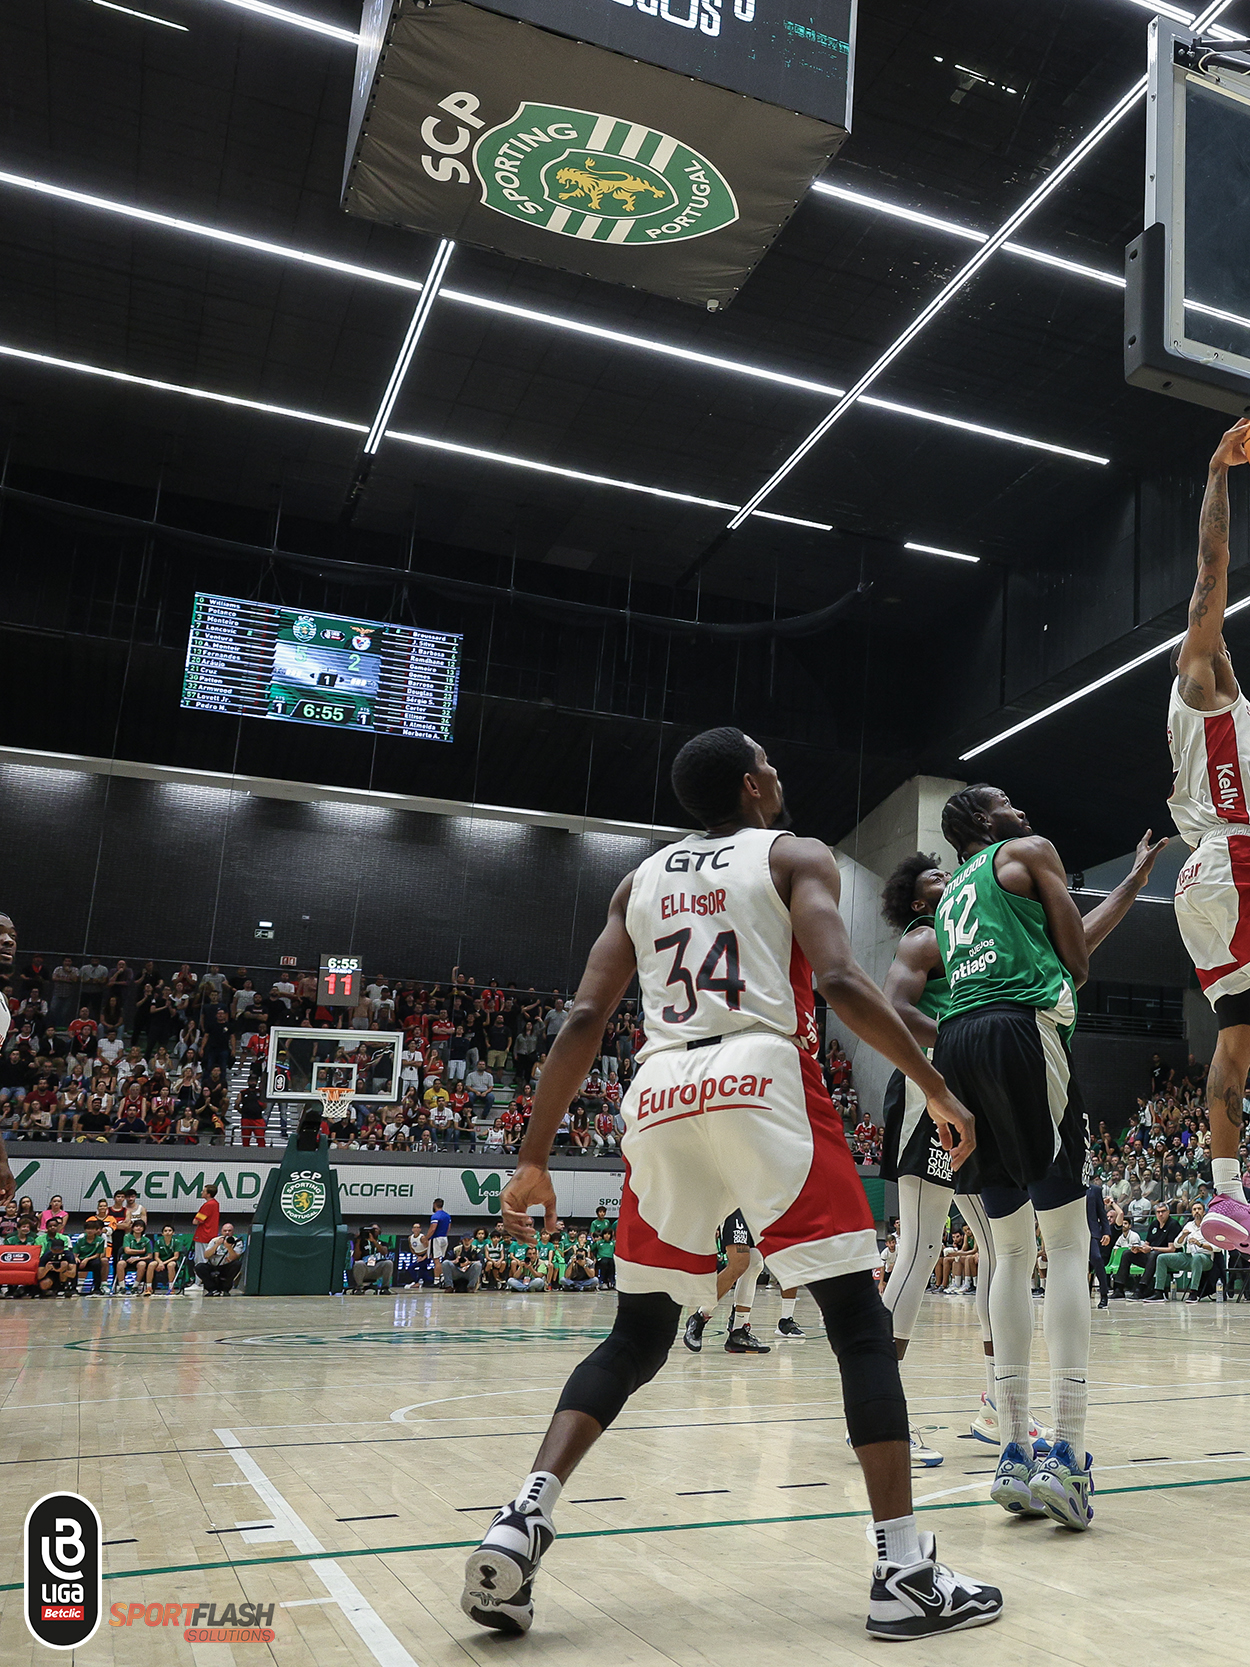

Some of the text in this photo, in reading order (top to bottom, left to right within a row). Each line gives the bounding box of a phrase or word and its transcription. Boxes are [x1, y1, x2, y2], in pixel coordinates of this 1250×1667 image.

[420, 91, 486, 184] SCP
[494, 122, 579, 215] SPORTING
[645, 159, 712, 239] PORTUGAL
[209, 599, 240, 609] Williams
[208, 608, 236, 617] Polanco
[207, 616, 239, 626] Monteiro
[205, 633, 233, 642] Ventura
[413, 632, 446, 641] Broussard
[203, 650, 240, 660] Fernandes
[295, 646, 308, 662] 5
[418, 649, 445, 657] Barbosa
[201, 659, 225, 667] Araújo
[348, 654, 361, 671] 2
[324, 676, 330, 685] 1
[198, 684, 232, 694] Armwood
[407, 689, 433, 697] Douglas
[197, 693, 220, 701] Lovett
[196, 702, 217, 710] Pedro
[276, 703, 283, 713] 1
[304, 704, 344, 721] 6:55
[360, 715, 366, 724] 1
[409, 722, 436, 730] Almeida
[1215, 763, 1239, 811] Kelly
[665, 846, 735, 873] GTC
[661, 888, 726, 920] ELLISOR
[939, 882, 979, 962] 32
[327, 957, 358, 970] 6:55
[654, 927, 746, 1024] 34
[324, 973, 353, 995] 11
[637, 1074, 773, 1121] Europcar
[289, 1170, 322, 1181] SCP
[927, 1165, 953, 1182] DADE
[83, 1170, 261, 1199] AZEMAD
[286, 1181, 322, 1195] SPORTING
[286, 1209, 319, 1220] PORTUGAL
